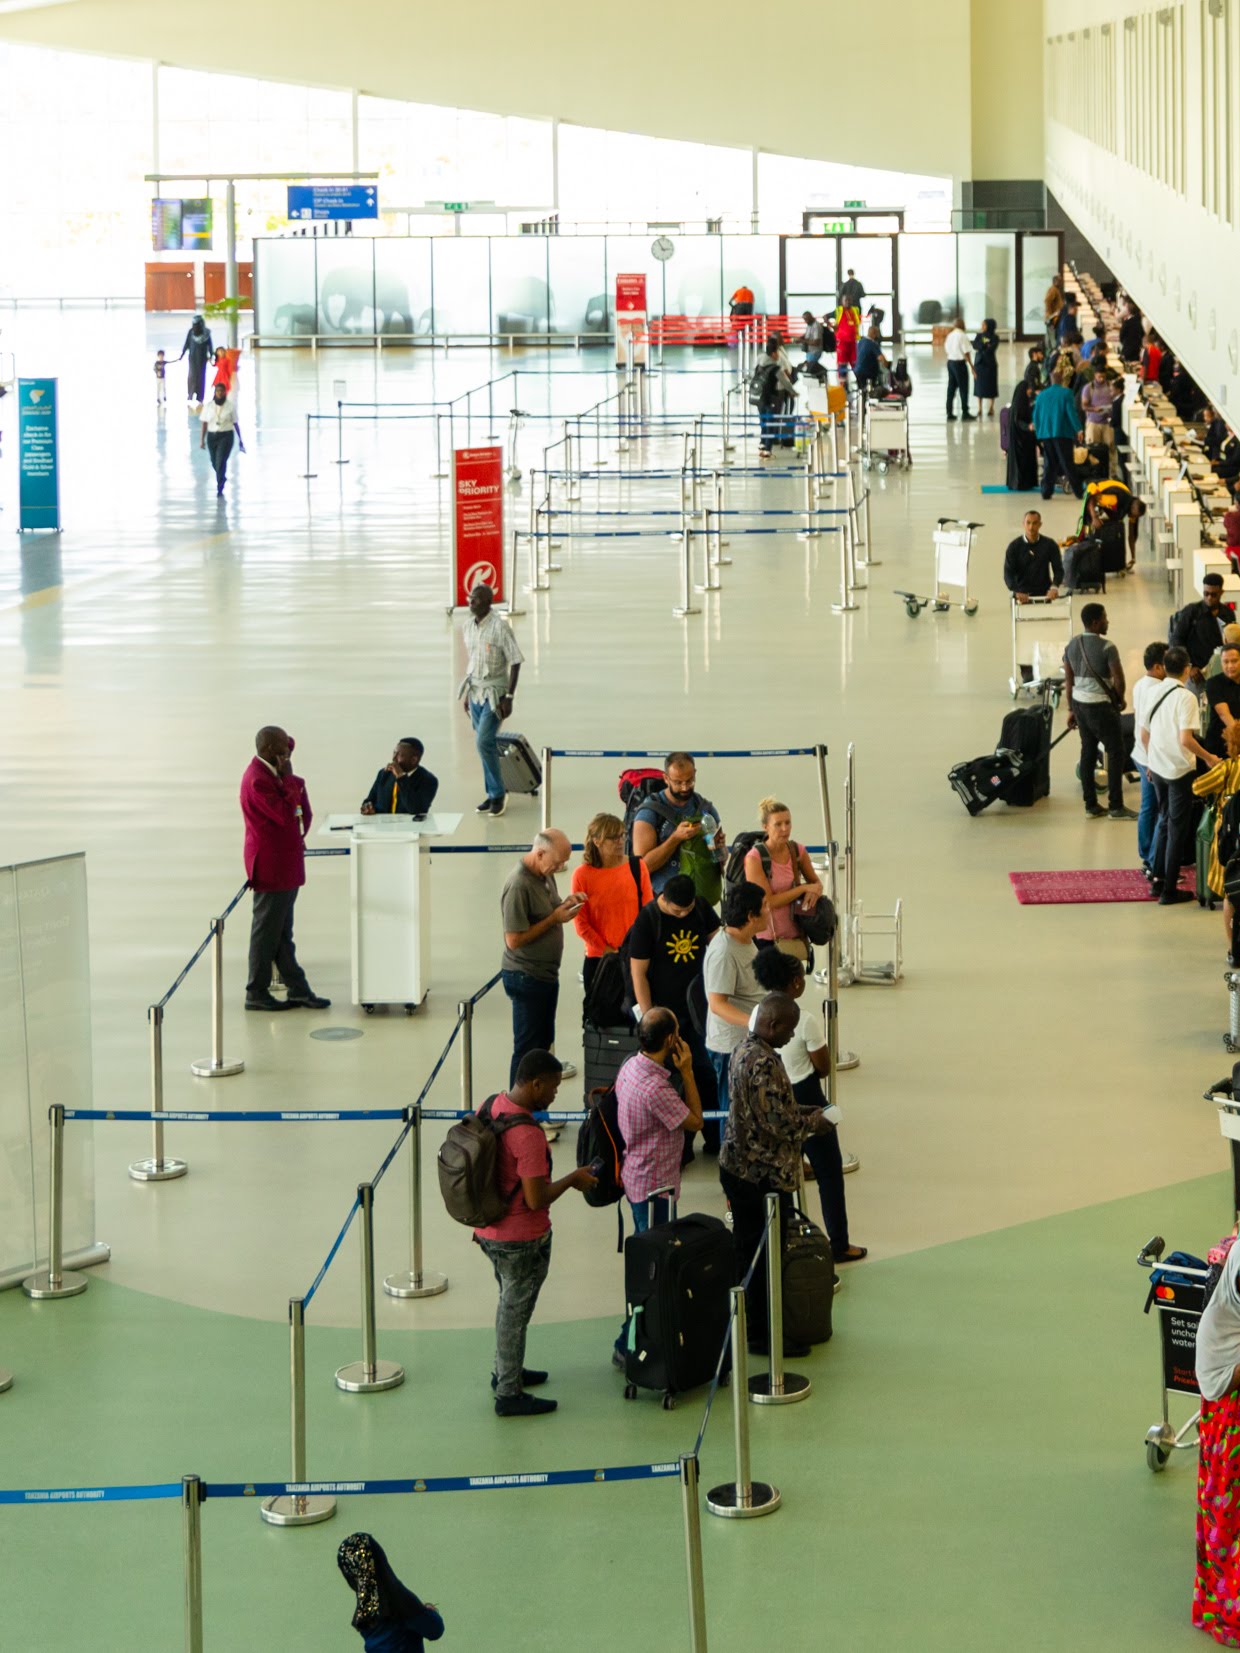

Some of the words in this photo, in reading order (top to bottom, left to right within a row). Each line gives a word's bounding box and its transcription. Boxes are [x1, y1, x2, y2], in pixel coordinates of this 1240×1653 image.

[458, 480, 478, 488] SKY
[458, 486, 500, 495] PRIORITY
[1171, 1316, 1186, 1328] Set
[1186, 1320, 1199, 1329] sai
[1171, 1328, 1196, 1339] uncha
[1171, 1338, 1196, 1348] water
[652, 1464, 674, 1473] TANZANIA
[469, 1476, 494, 1486] TANZANIA
[494, 1475, 519, 1485] AIRPORTS
[520, 1474, 548, 1484] AUTHORITY
[285, 1483, 310, 1492] TANZANIA
[310, 1483, 336, 1492] AIRPORTS
[336, 1482, 365, 1491] AUTHORITY
[25, 1492, 49, 1500] TANZANIA
[50, 1491, 76, 1499] AIRPORTS
